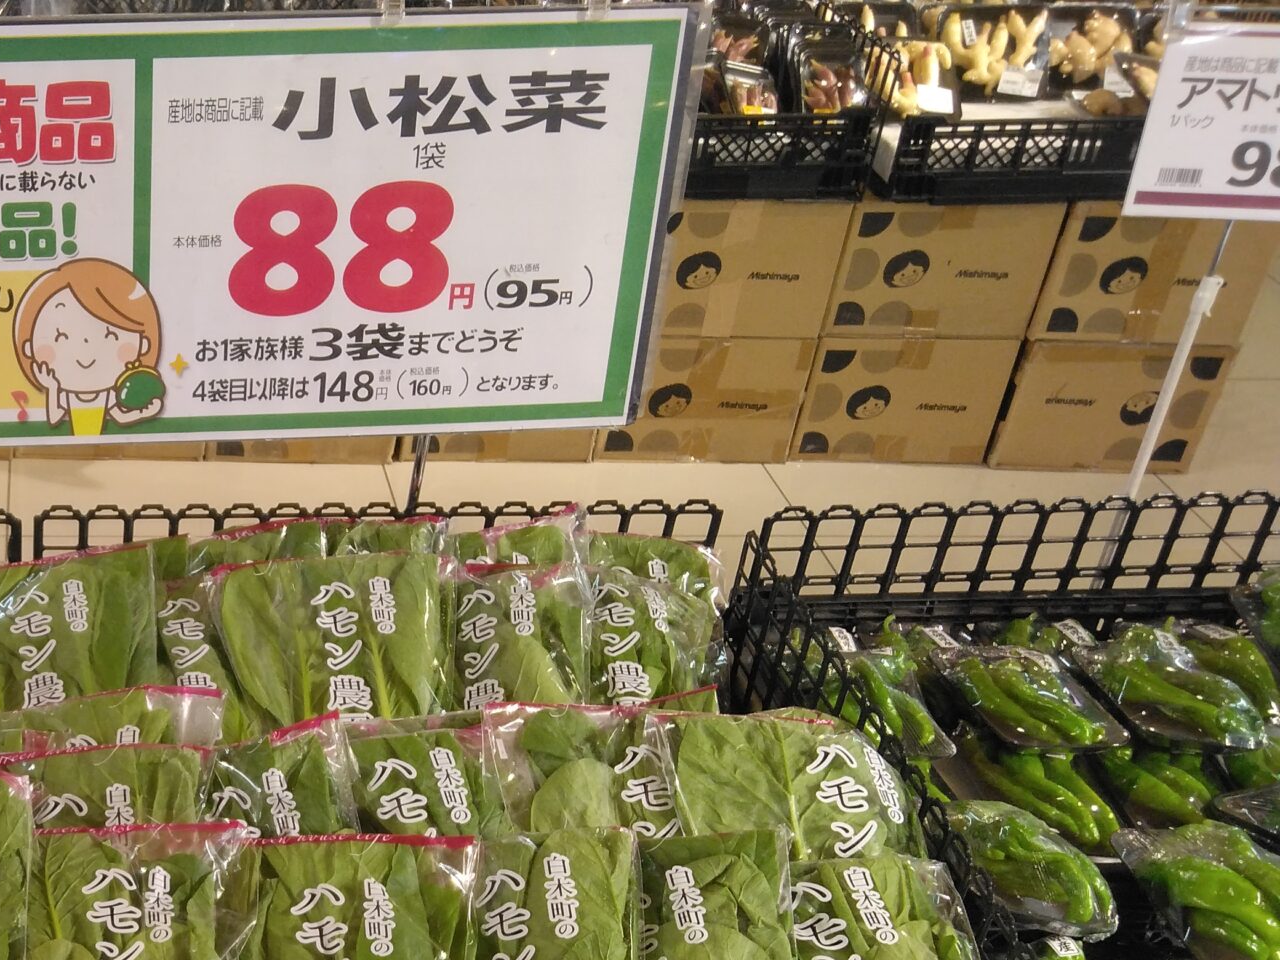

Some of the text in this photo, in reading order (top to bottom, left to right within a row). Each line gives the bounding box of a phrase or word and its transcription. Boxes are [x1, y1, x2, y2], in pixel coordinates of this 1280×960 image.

[167, 97, 264, 124] 産地は商品に記載
[272, 70, 610, 140] 小松菜
[412, 142, 446, 170] 1袋
[172, 234, 222, 249] 本体価格
[955, 269, 1009, 280] Mishimaya
[747, 272, 800, 282] Mishimaya
[62, 579, 89, 633] 白木町の
[368, 576, 395, 634] 白木町の
[430, 747, 472, 824] 白木町の
[863, 744, 905, 825] 白木町の
[144, 866, 174, 943] 白木町の
[363, 878, 394, 957] 白木町の
[542, 852, 579, 940] 白木町の
[665, 864, 708, 944] 白木町の
[843, 866, 899, 945] 白木町の
